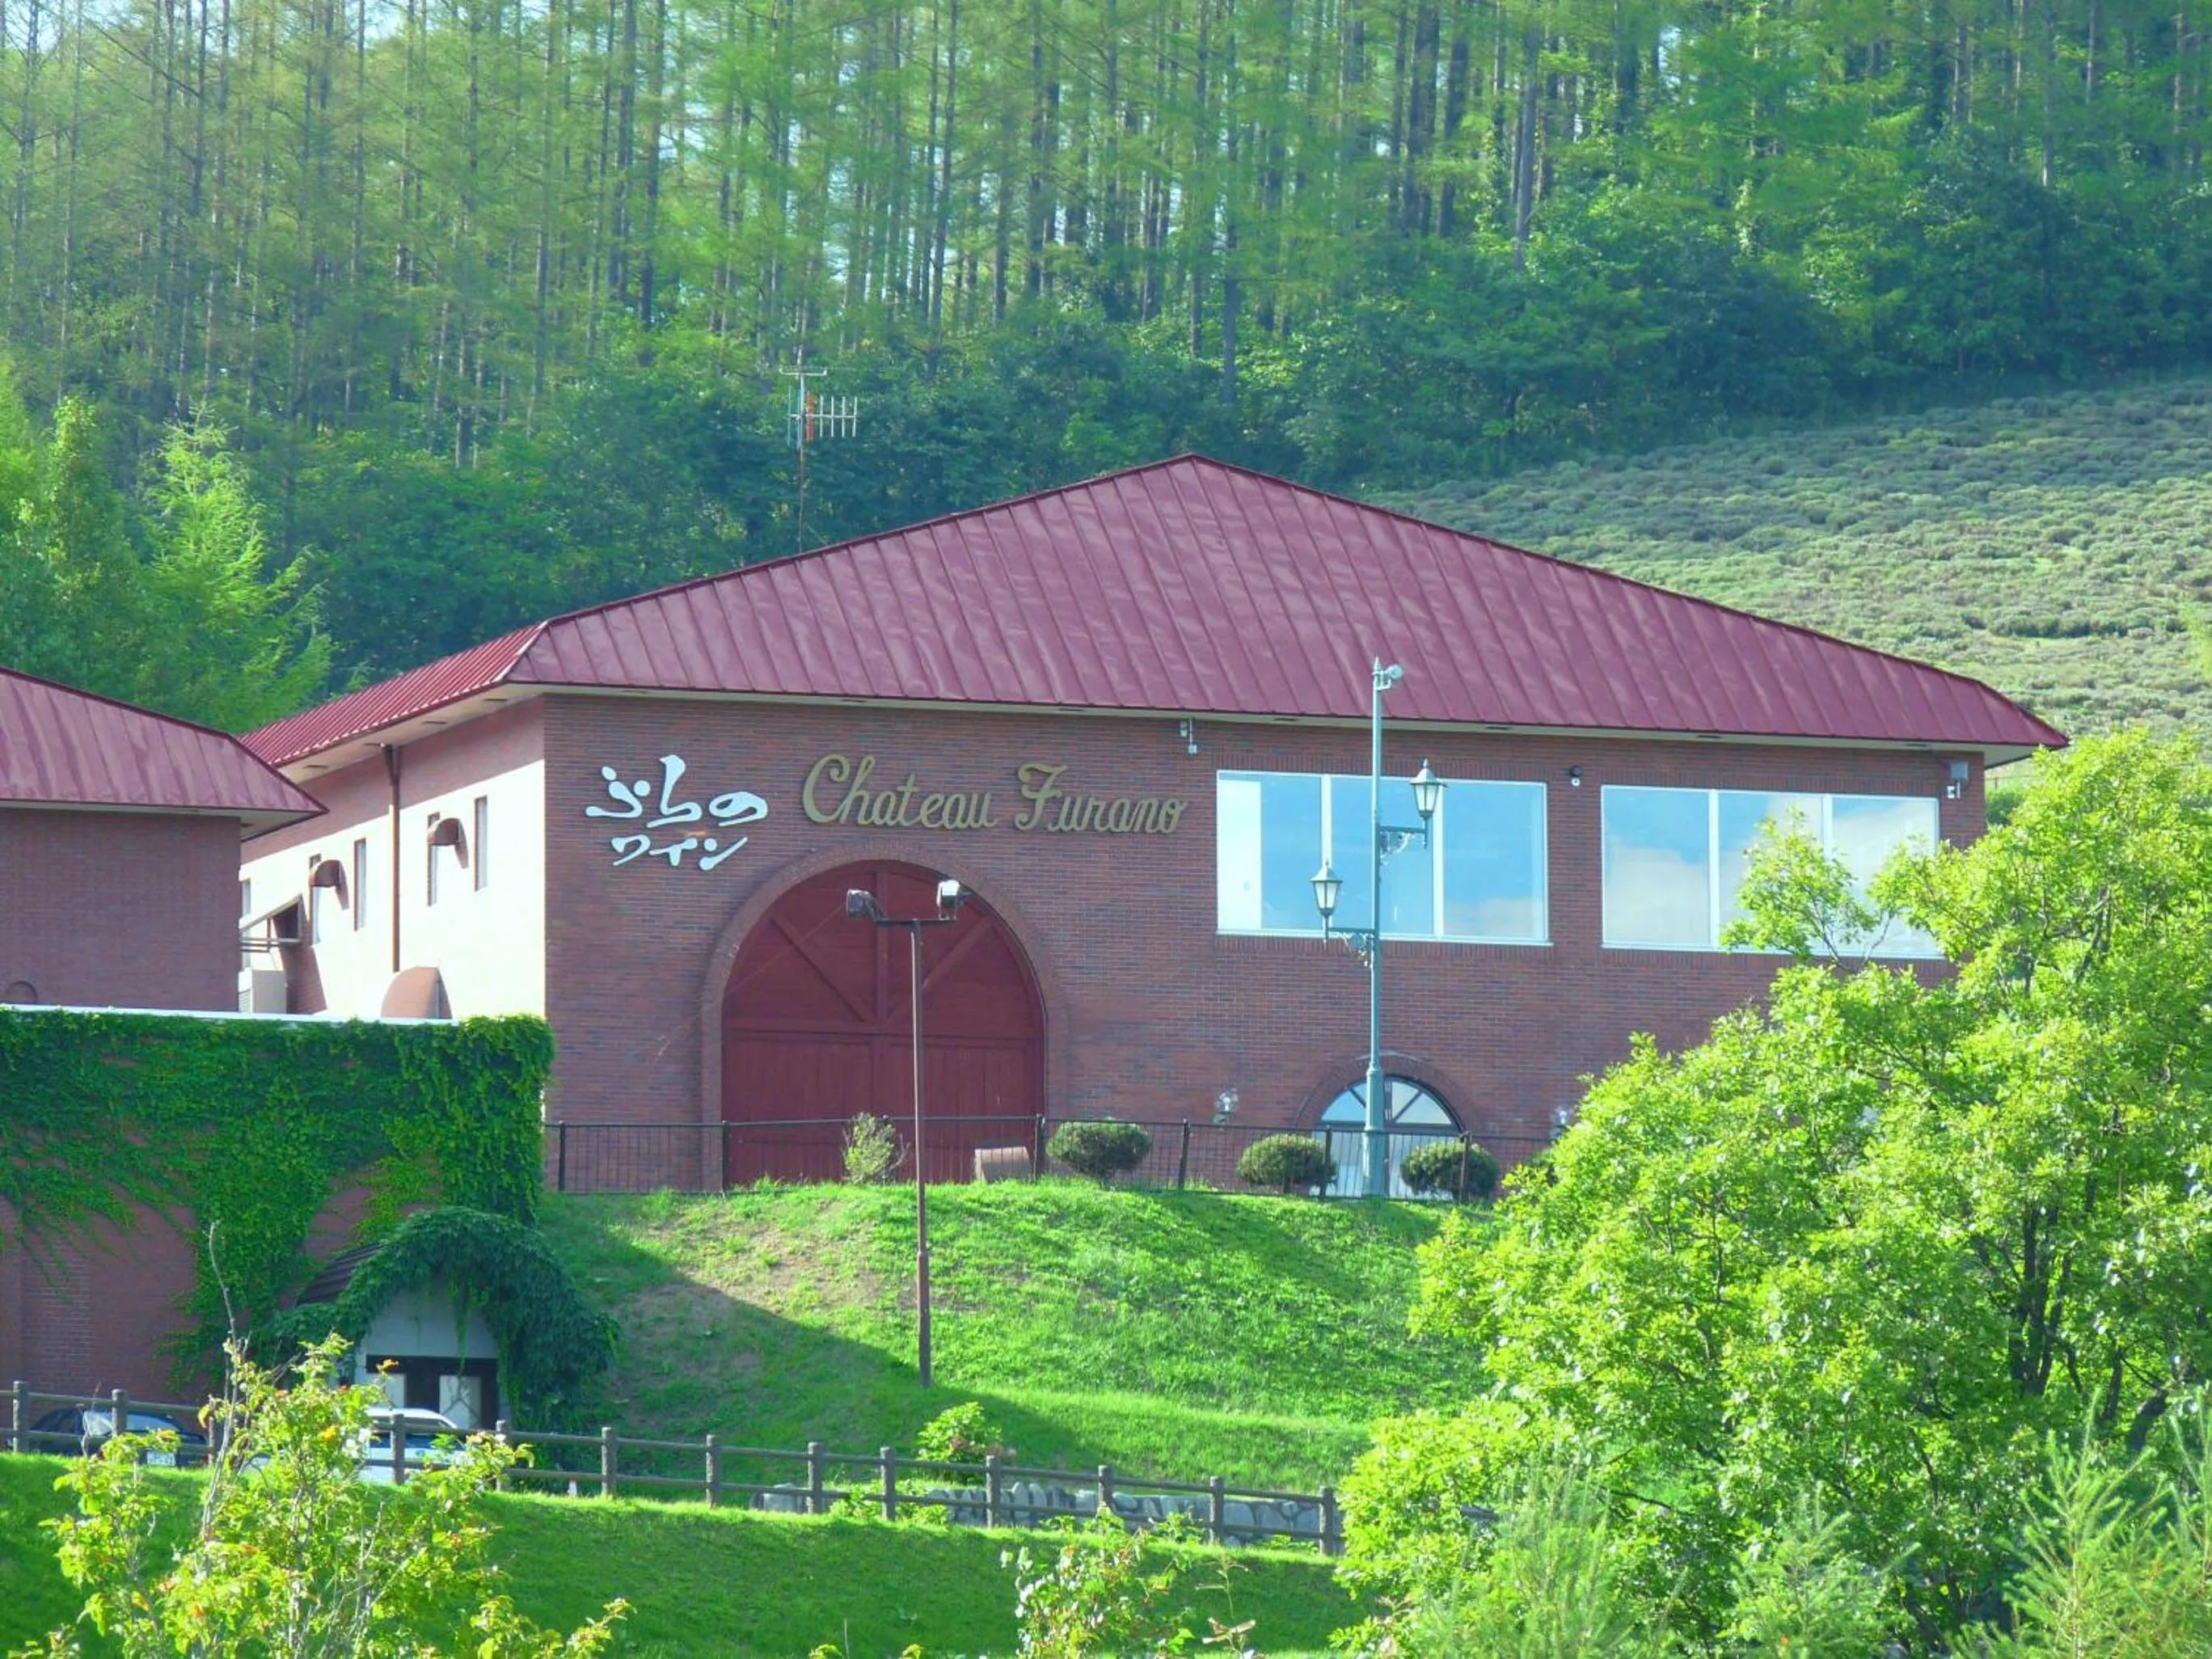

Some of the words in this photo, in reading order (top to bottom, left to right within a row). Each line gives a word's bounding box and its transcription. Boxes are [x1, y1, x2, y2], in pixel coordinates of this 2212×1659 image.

[585, 754, 768, 828] ふらの
[802, 753, 1000, 830] Chateau
[1014, 762, 1188, 834] Furano
[611, 834, 749, 871] ワイン
